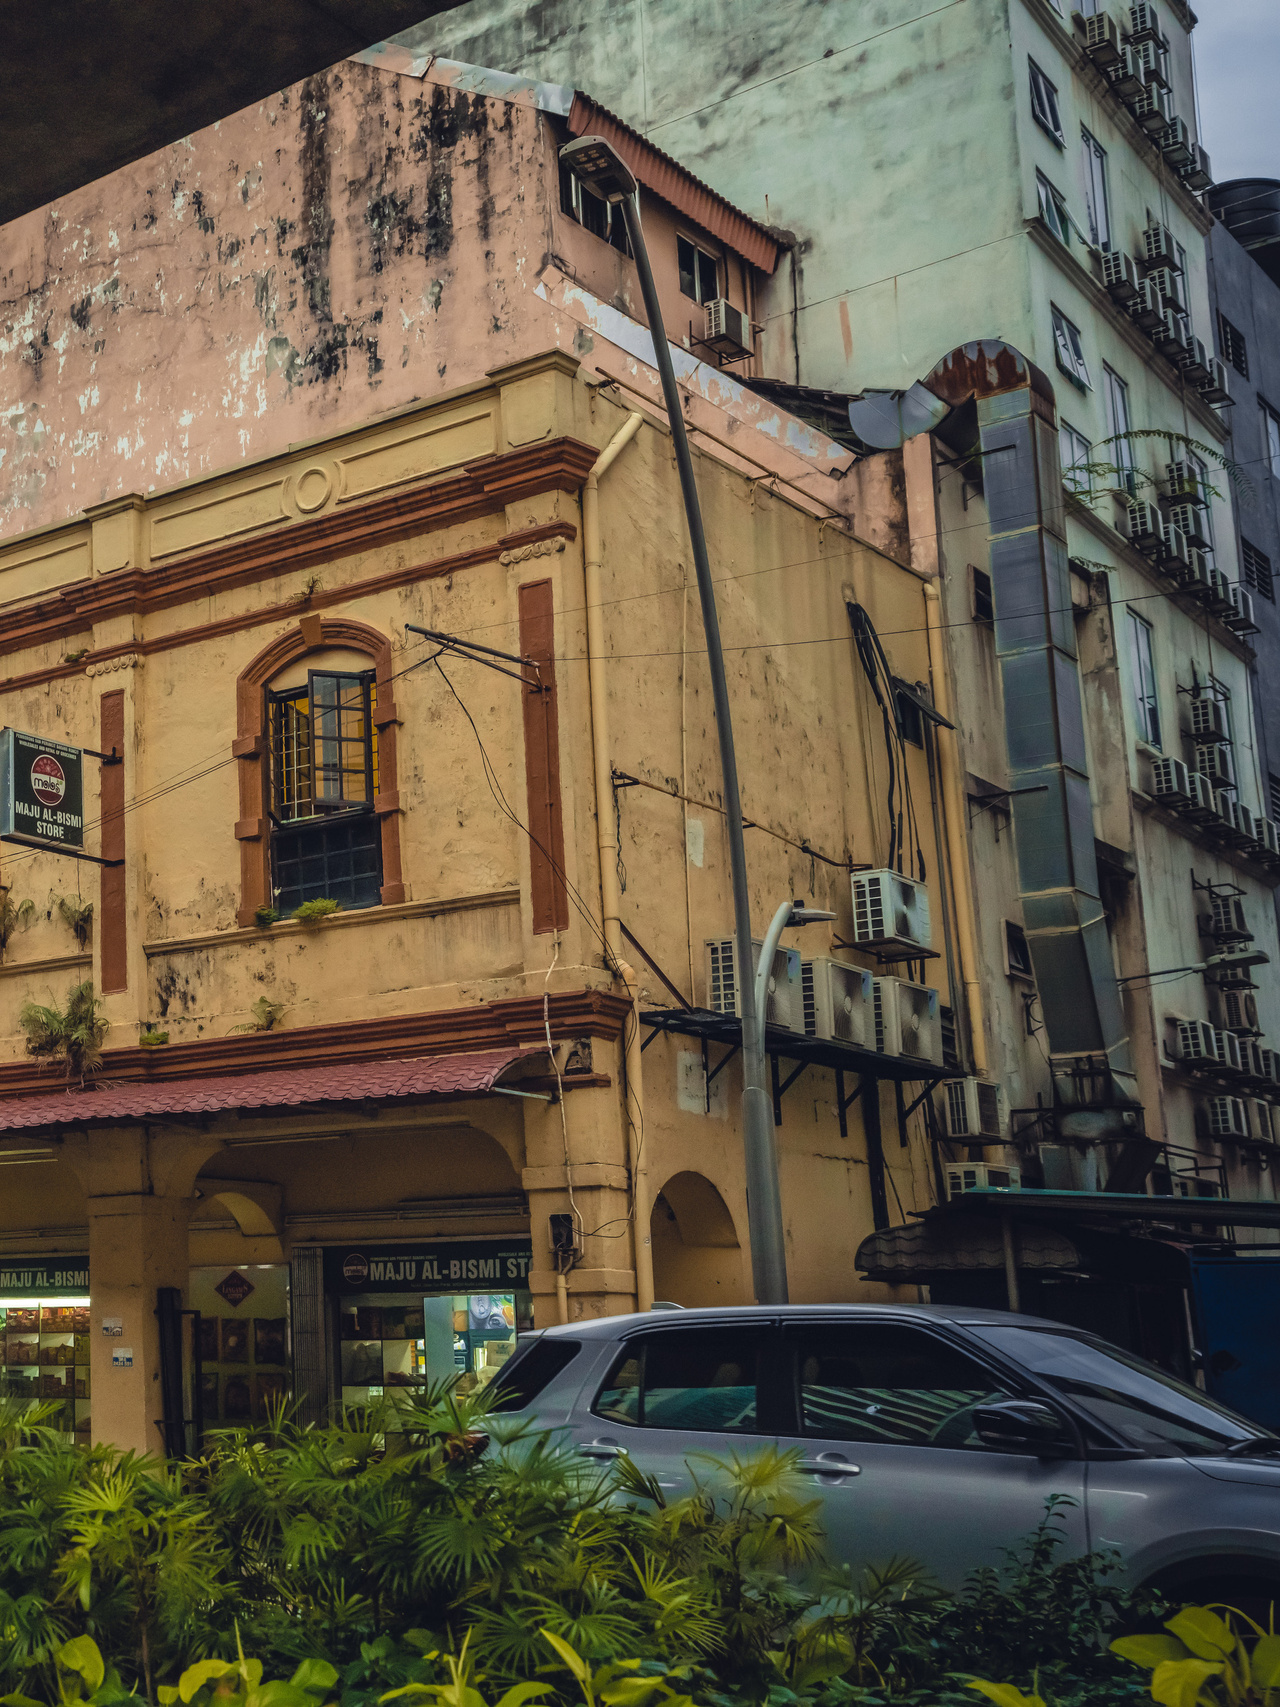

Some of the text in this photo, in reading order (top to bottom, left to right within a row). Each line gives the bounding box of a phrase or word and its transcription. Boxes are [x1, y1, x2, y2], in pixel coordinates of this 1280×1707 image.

[15, 800, 82, 828] MAJU AL-BISMI
[36, 821, 64, 839] STORE
[0, 1272, 32, 1288] MAJU
[36, 1270, 89, 1287] AL-BISMI
[370, 1261, 416, 1281] MAJU
[422, 1258, 501, 1280] AL-BISMI
